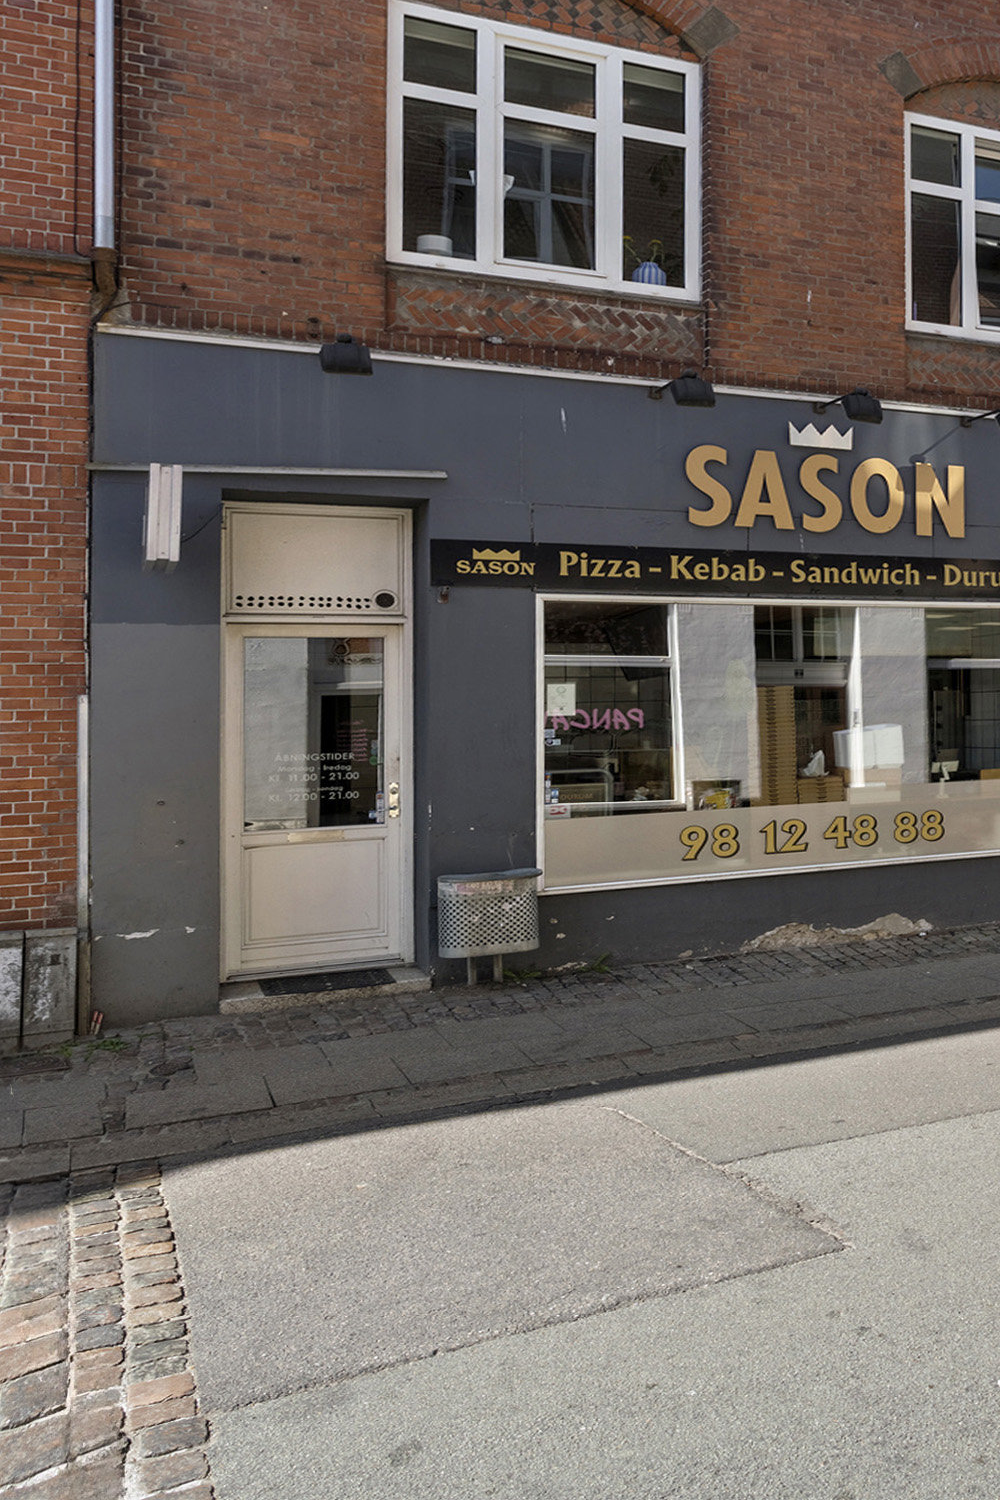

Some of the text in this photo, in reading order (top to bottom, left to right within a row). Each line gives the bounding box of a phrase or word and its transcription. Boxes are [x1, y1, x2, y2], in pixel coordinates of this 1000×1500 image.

[684, 444, 965, 538] SASON
[456, 560, 536, 576] SASON
[559, 551, 641, 578] Pizza
[670, 555, 766, 582] Kebab
[790, 559, 920, 586] Sandwich
[329, 771, 360, 781] 21.00
[329, 791, 360, 800] 21.00
[679, 810, 945, 861] 98 12 48 88
